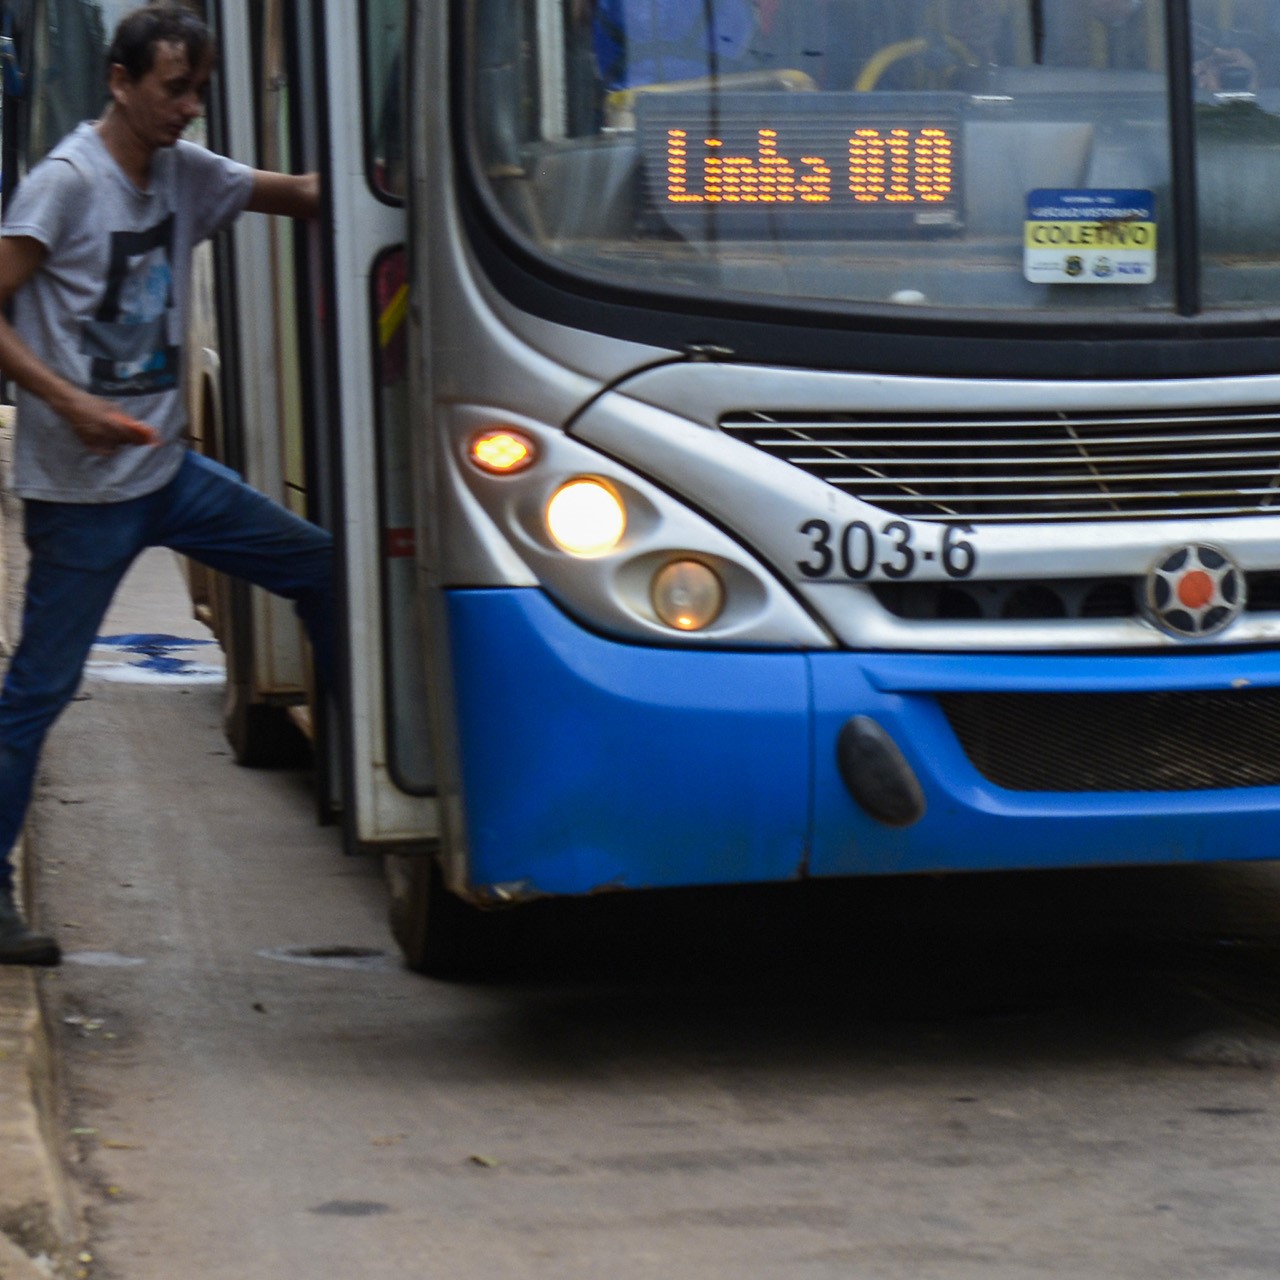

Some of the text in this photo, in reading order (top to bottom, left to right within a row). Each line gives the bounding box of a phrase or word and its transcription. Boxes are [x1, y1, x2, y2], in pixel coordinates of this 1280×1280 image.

[667, 128, 952, 202] Linha 010
[1032, 225, 1149, 245] COLETIVO
[797, 519, 976, 579] 303-6
